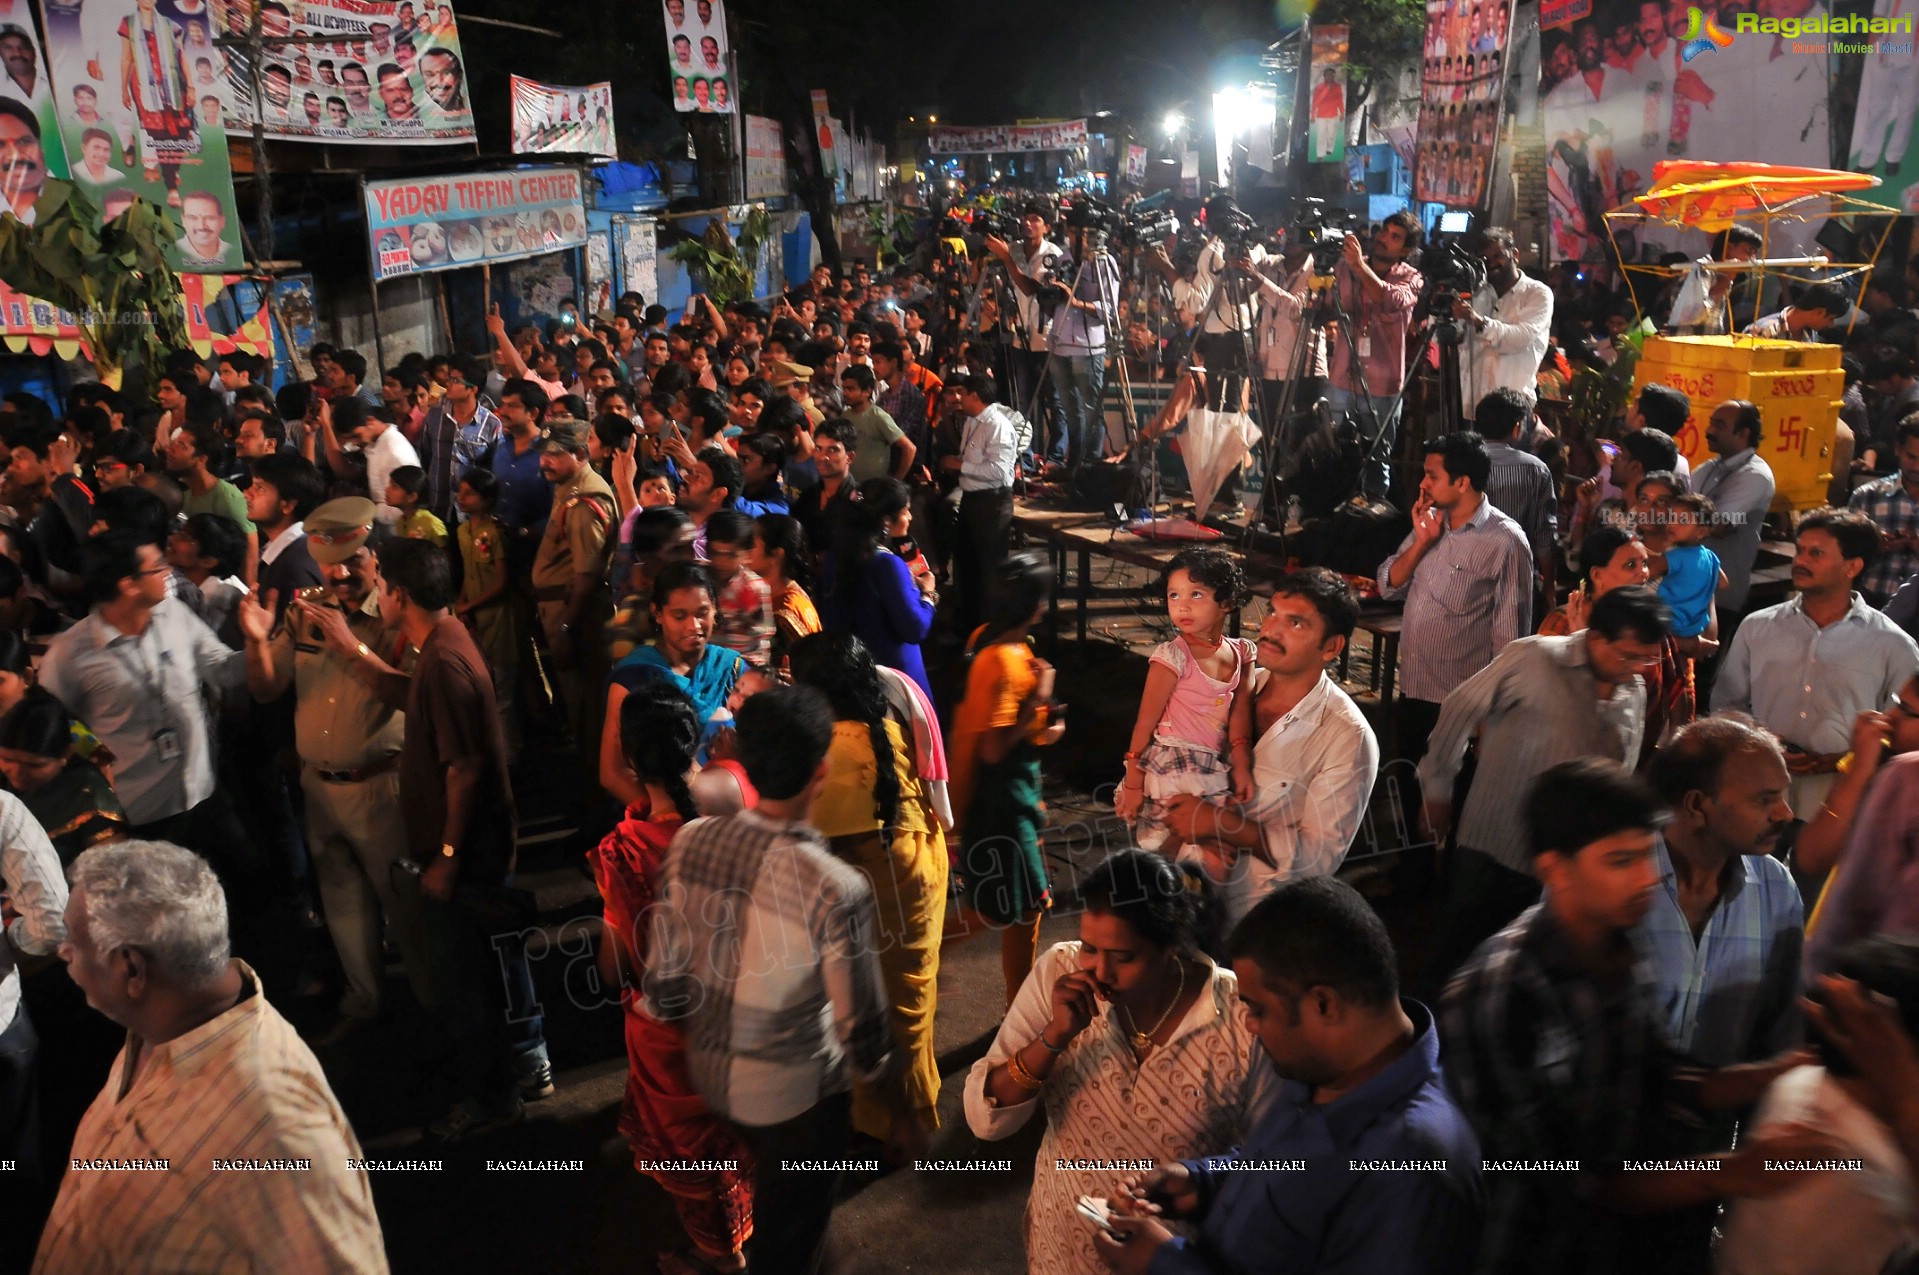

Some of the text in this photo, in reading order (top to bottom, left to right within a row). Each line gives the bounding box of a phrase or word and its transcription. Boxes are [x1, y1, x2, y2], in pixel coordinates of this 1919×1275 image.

[306, 11, 369, 33] ALL DEVOTEES
[373, 172, 580, 223] YADAV TIFFIN CENTER
